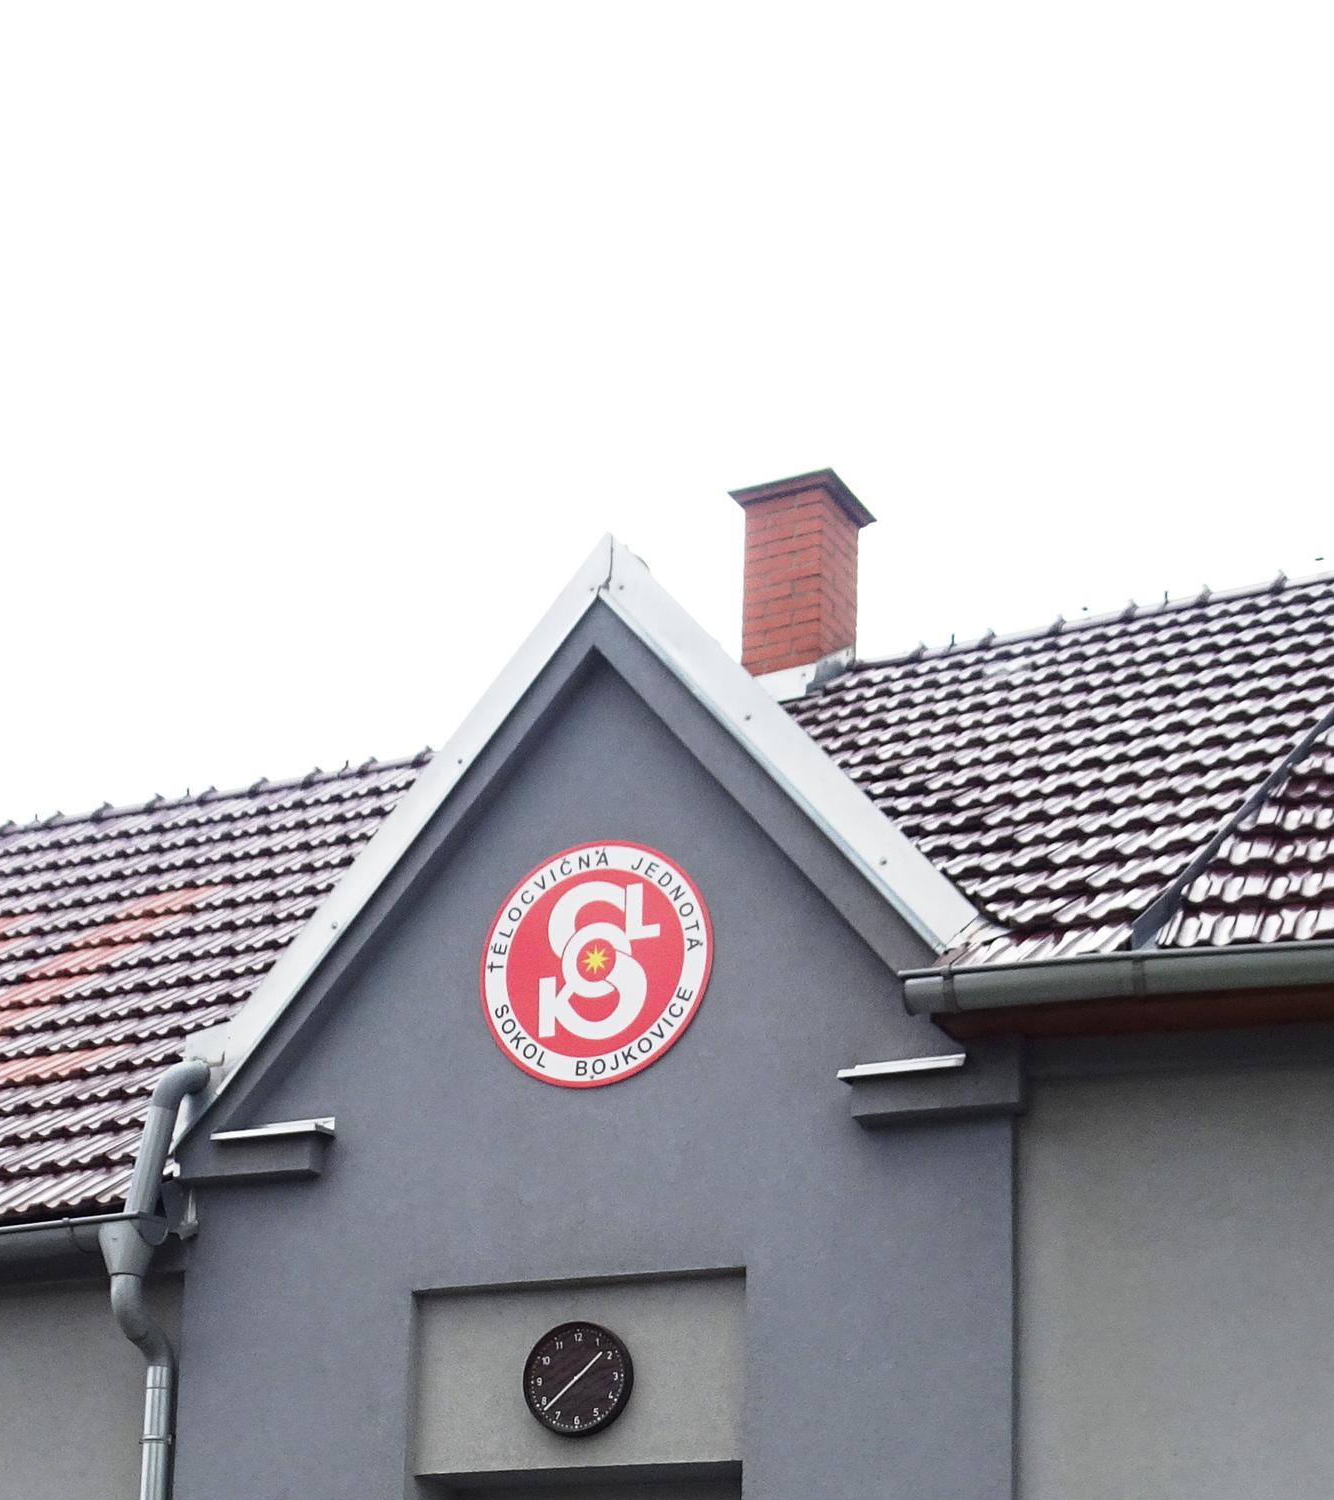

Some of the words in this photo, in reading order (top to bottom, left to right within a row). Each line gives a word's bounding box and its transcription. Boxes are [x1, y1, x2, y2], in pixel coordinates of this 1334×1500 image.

[487, 848, 609, 973] TĚLOCVIČNÁ
[631, 857, 703, 951] JEDNOTA
[494, 1004, 546, 1068] SOKOL
[575, 986, 693, 1076] BOJKOVICE
